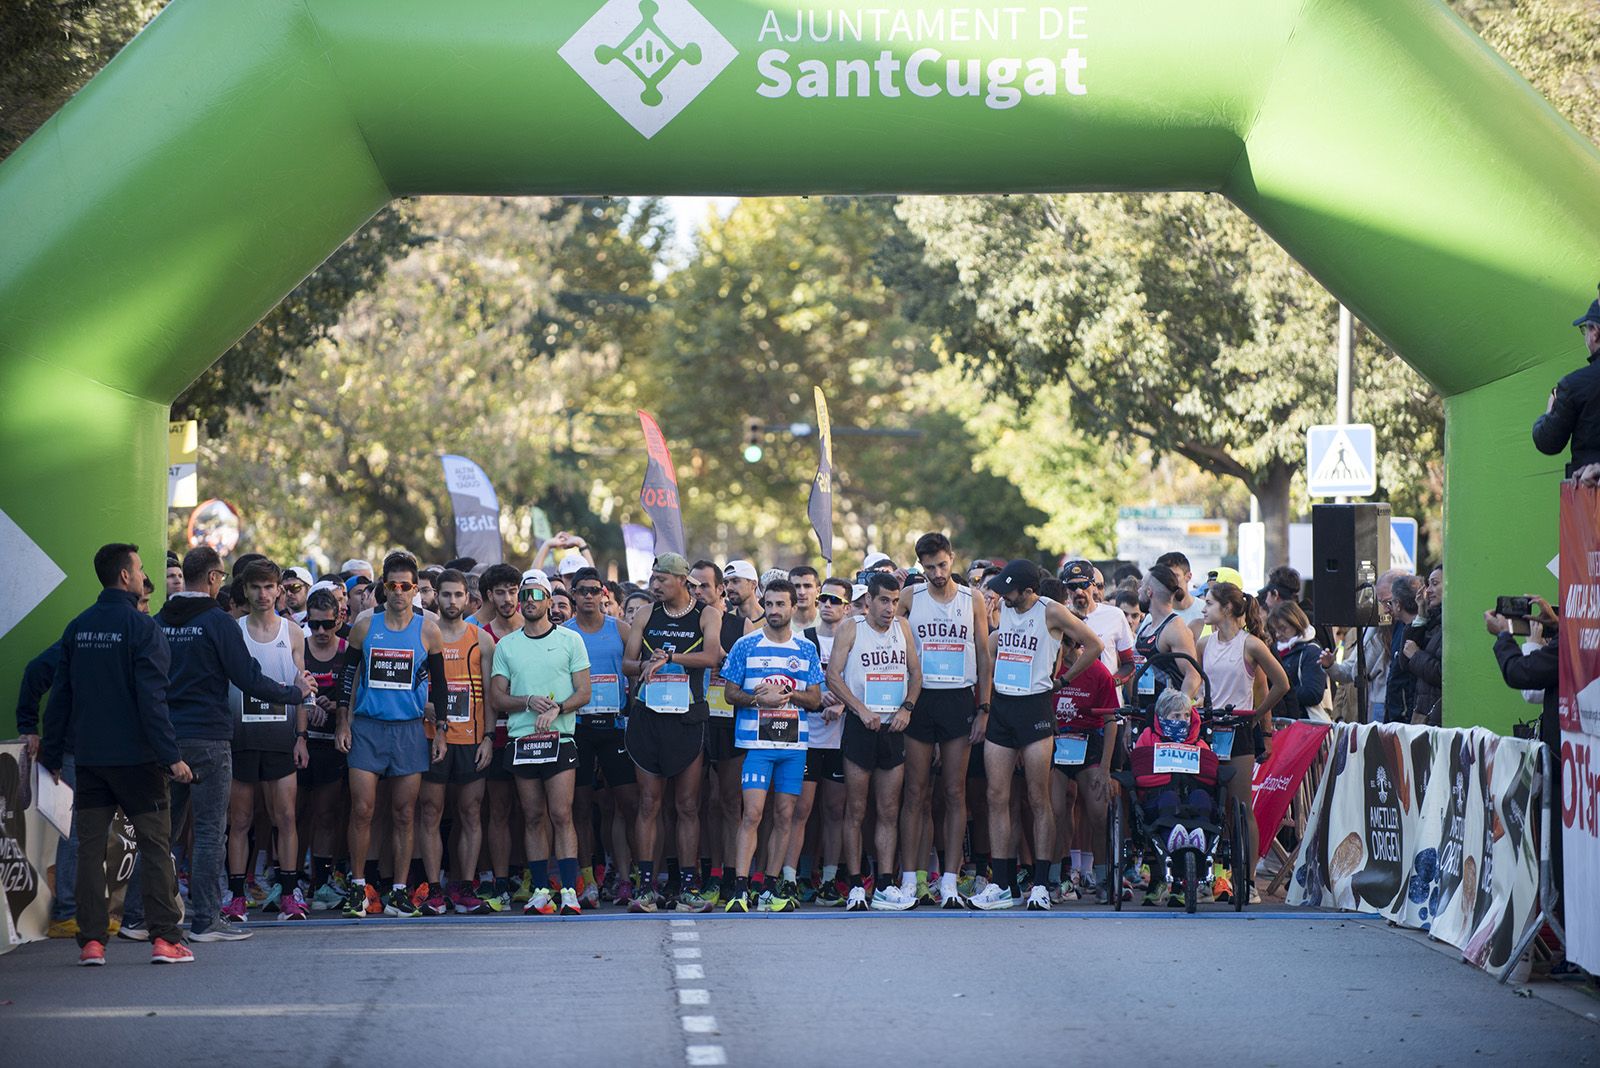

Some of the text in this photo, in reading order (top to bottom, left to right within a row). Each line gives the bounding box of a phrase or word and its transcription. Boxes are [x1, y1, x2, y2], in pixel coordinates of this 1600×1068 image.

[758, 7, 1088, 42] AJUNTAMENT DE
[755, 48, 1088, 109] SantCugat
[917, 623, 968, 640] SUGAR
[998, 632, 1039, 651] SUGAR
[374, 660, 409, 670] JORGE JUAN
[860, 650, 906, 667] SUGAR
[771, 721, 788, 730] JOSEP
[523, 742, 553, 750] BERNARDO
[1372, 830, 1401, 862] ORIGEN
